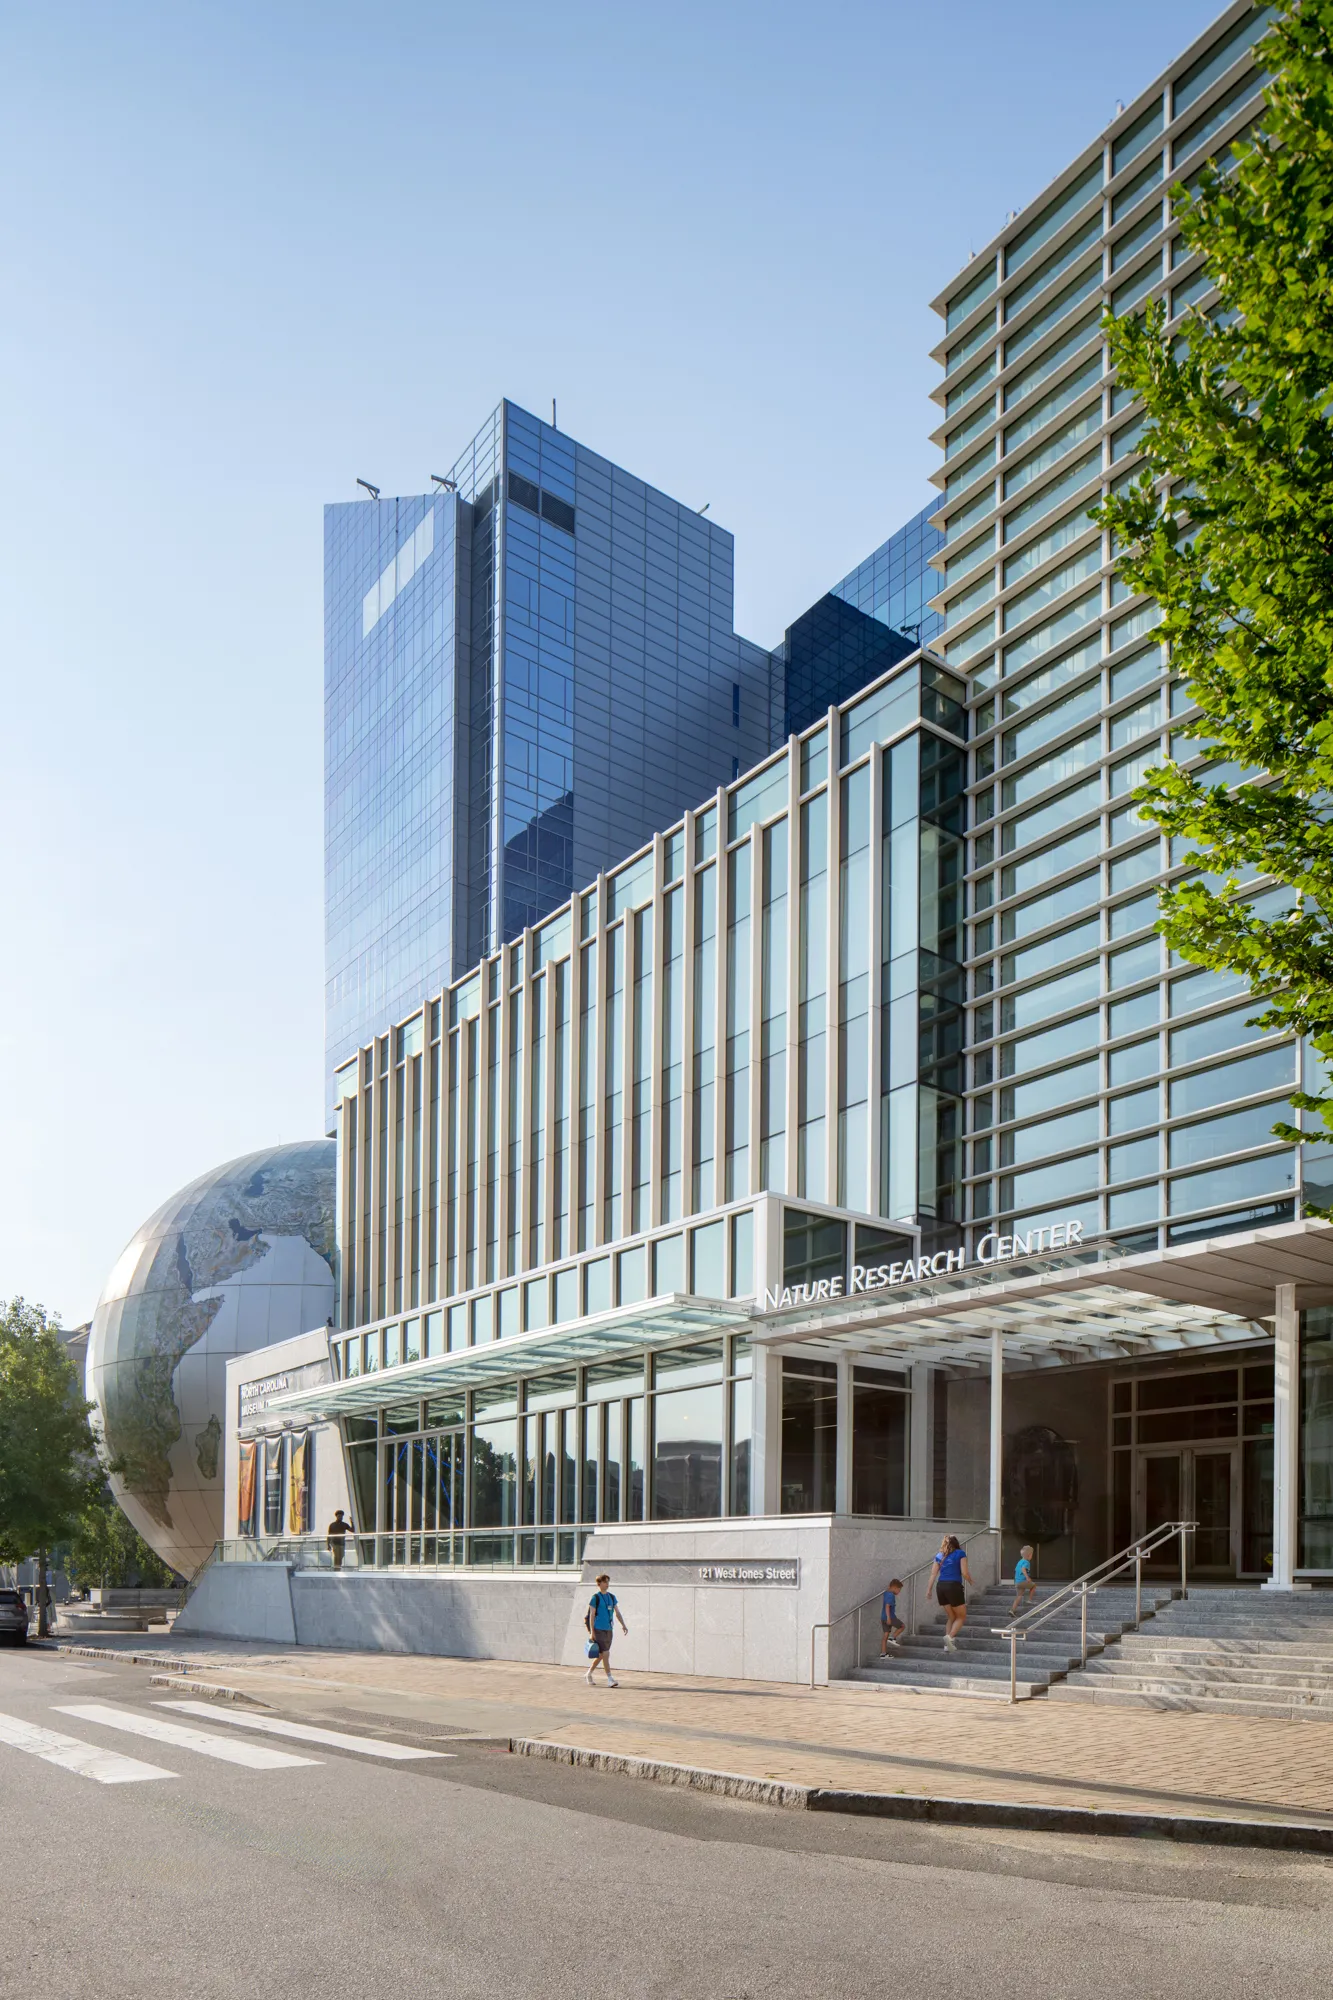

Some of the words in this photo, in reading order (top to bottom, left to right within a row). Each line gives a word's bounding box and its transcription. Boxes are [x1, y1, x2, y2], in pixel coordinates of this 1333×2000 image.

[764, 1275, 842, 1312] NATURE
[850, 1247, 965, 1293] RESEARCH
[977, 1219, 1084, 1264] CENTER
[241, 1385, 259, 1399] NORTH
[260, 1377, 287, 1394] CAROLINA
[241, 1400, 264, 1417] MUSEUM
[698, 1567, 712, 1578] 121
[714, 1567, 736, 1579] West
[738, 1567, 764, 1579] Jones
[766, 1567, 795, 1579] Street
